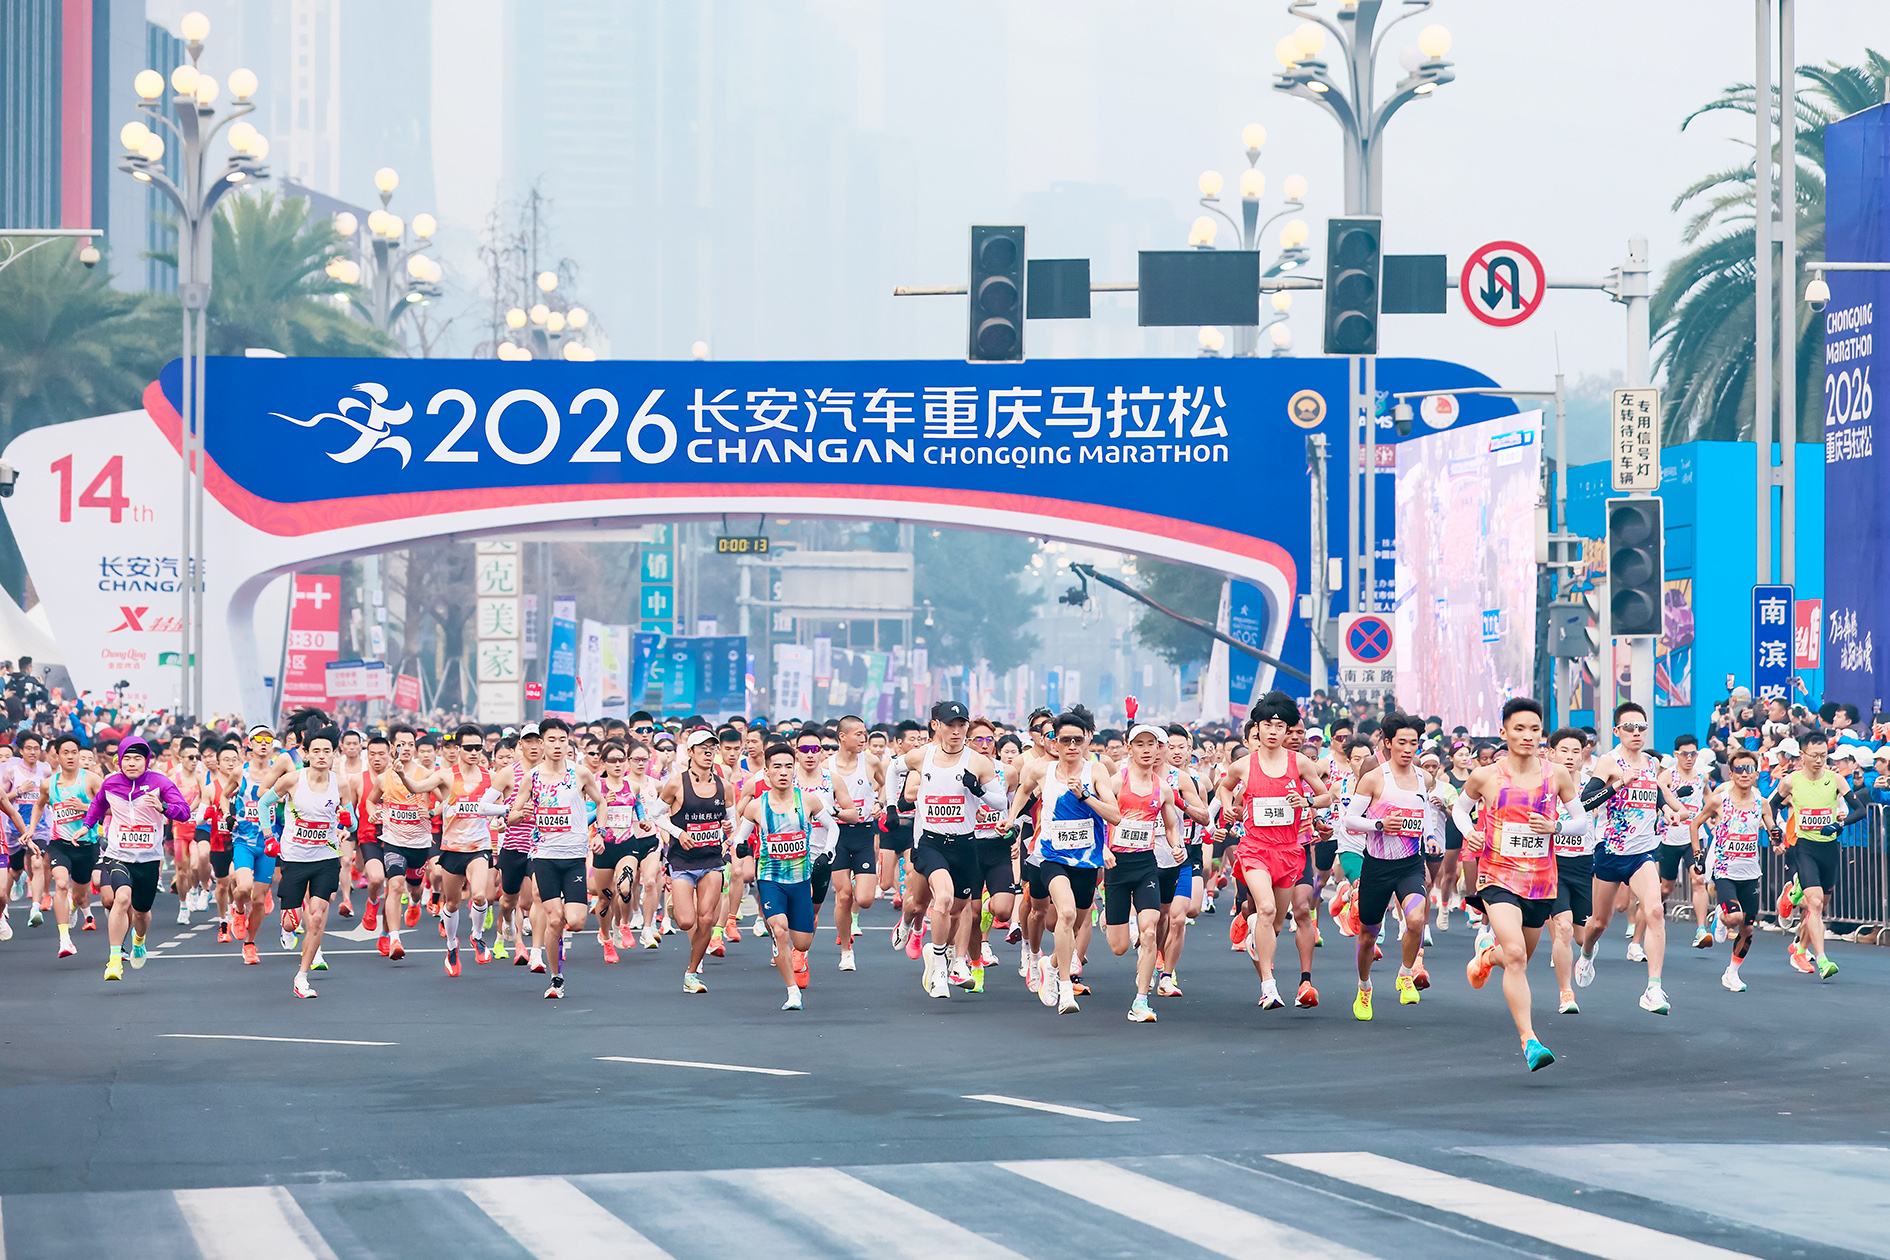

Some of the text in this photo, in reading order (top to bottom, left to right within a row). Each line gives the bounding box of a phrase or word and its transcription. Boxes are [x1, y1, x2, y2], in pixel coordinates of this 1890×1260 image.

[1825, 365, 1873, 426] 2026
[423, 388, 678, 465] 2026
[1619, 392, 1634, 485] 左转待行车辆
[1636, 399, 1651, 477] 专用信号灯
[686, 438, 915, 463] CHANGAN
[1826, 425, 1873, 464] 重庆马拉松
[1343, 669, 1395, 683] 南滨路
[391, 809, 417, 820] A00198
[927, 805, 962, 817] A00072
[538, 816, 569, 826] A02464
[1401, 818, 1422, 830] 0092
[1801, 815, 1831, 825] A00020
[121, 832, 150, 842] A00421
[296, 828, 327, 839] A00066
[1057, 830, 1089, 842] 杨定宏
[1120, 828, 1149, 841] 董国建
[1509, 835, 1544, 849] 丰配友
[1554, 834, 1582, 846] 02469
[771, 840, 805, 853] A00003
[1728, 842, 1757, 852] A02465
